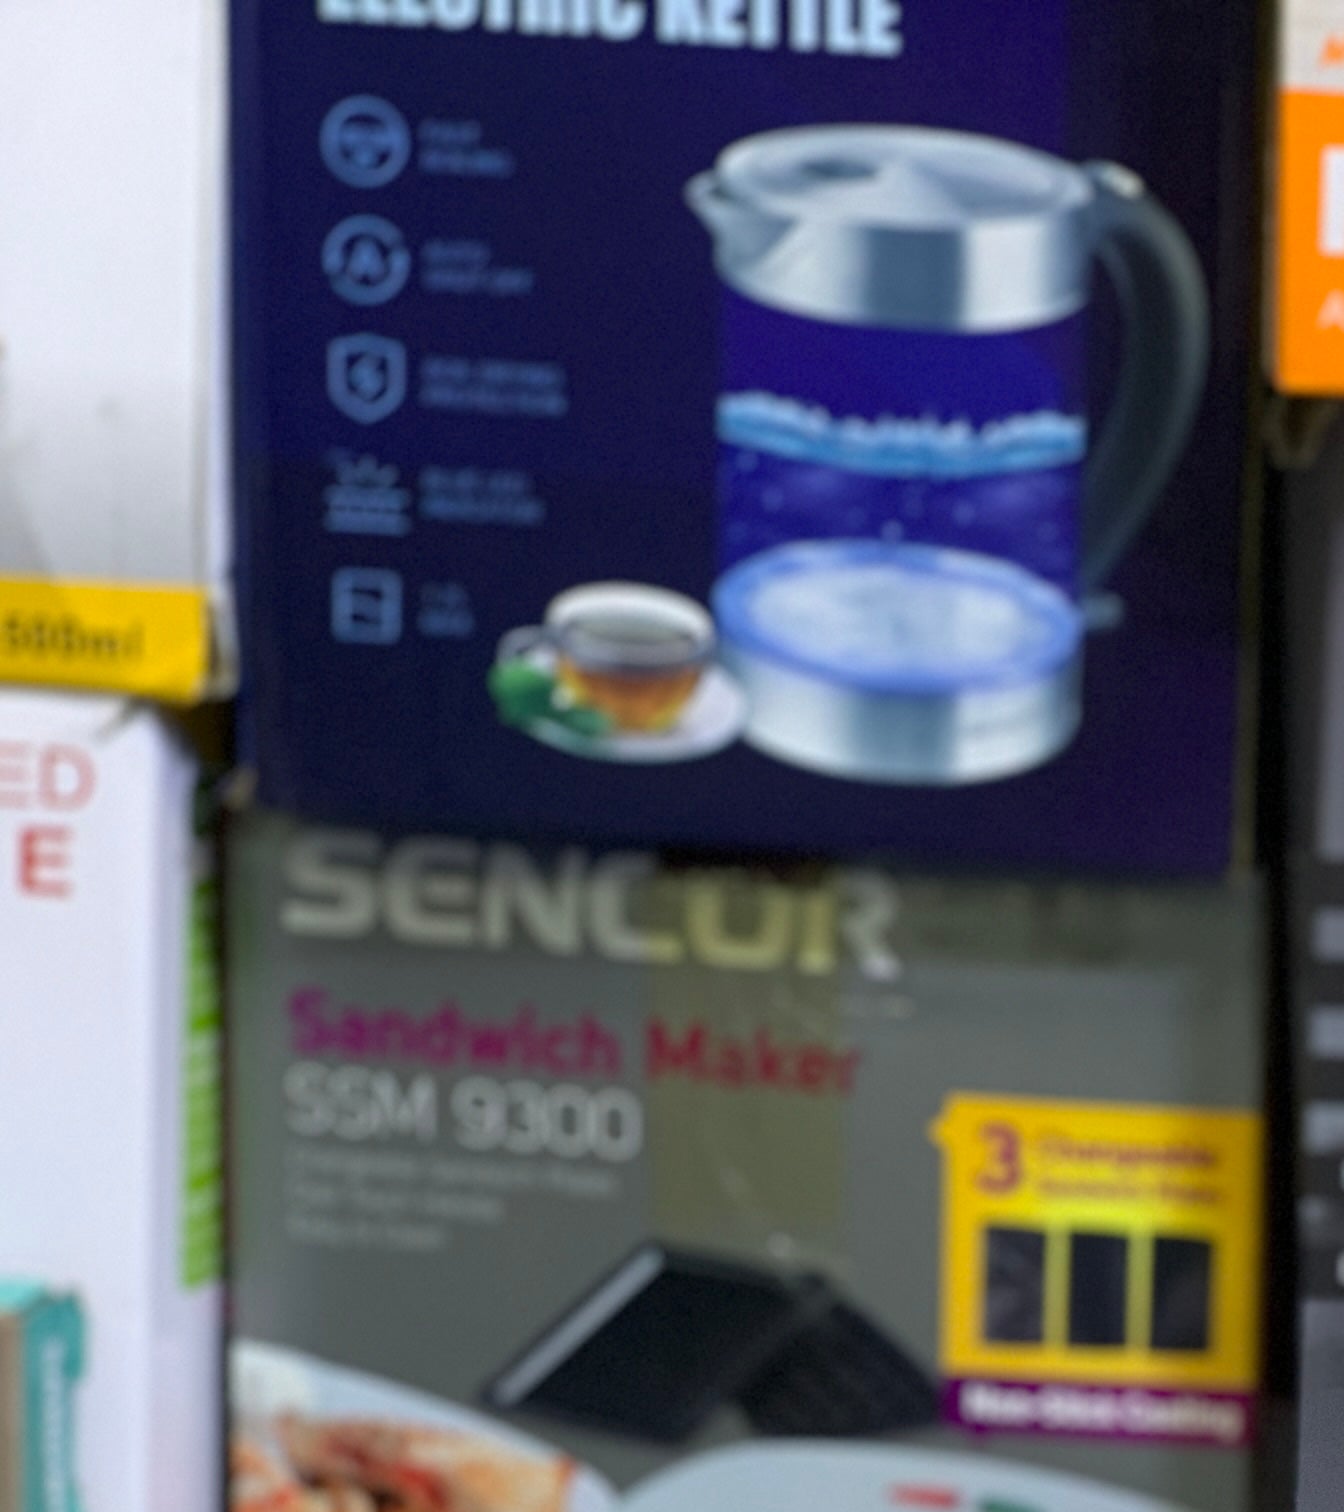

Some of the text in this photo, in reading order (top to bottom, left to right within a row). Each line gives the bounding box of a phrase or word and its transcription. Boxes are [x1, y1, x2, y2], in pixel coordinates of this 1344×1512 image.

[281, 827, 903, 982] SENCOR
[287, 986, 864, 1096] Sandwich Maker
[449, 1076, 644, 1165] 9300
[977, 1121, 1021, 1196] 3
